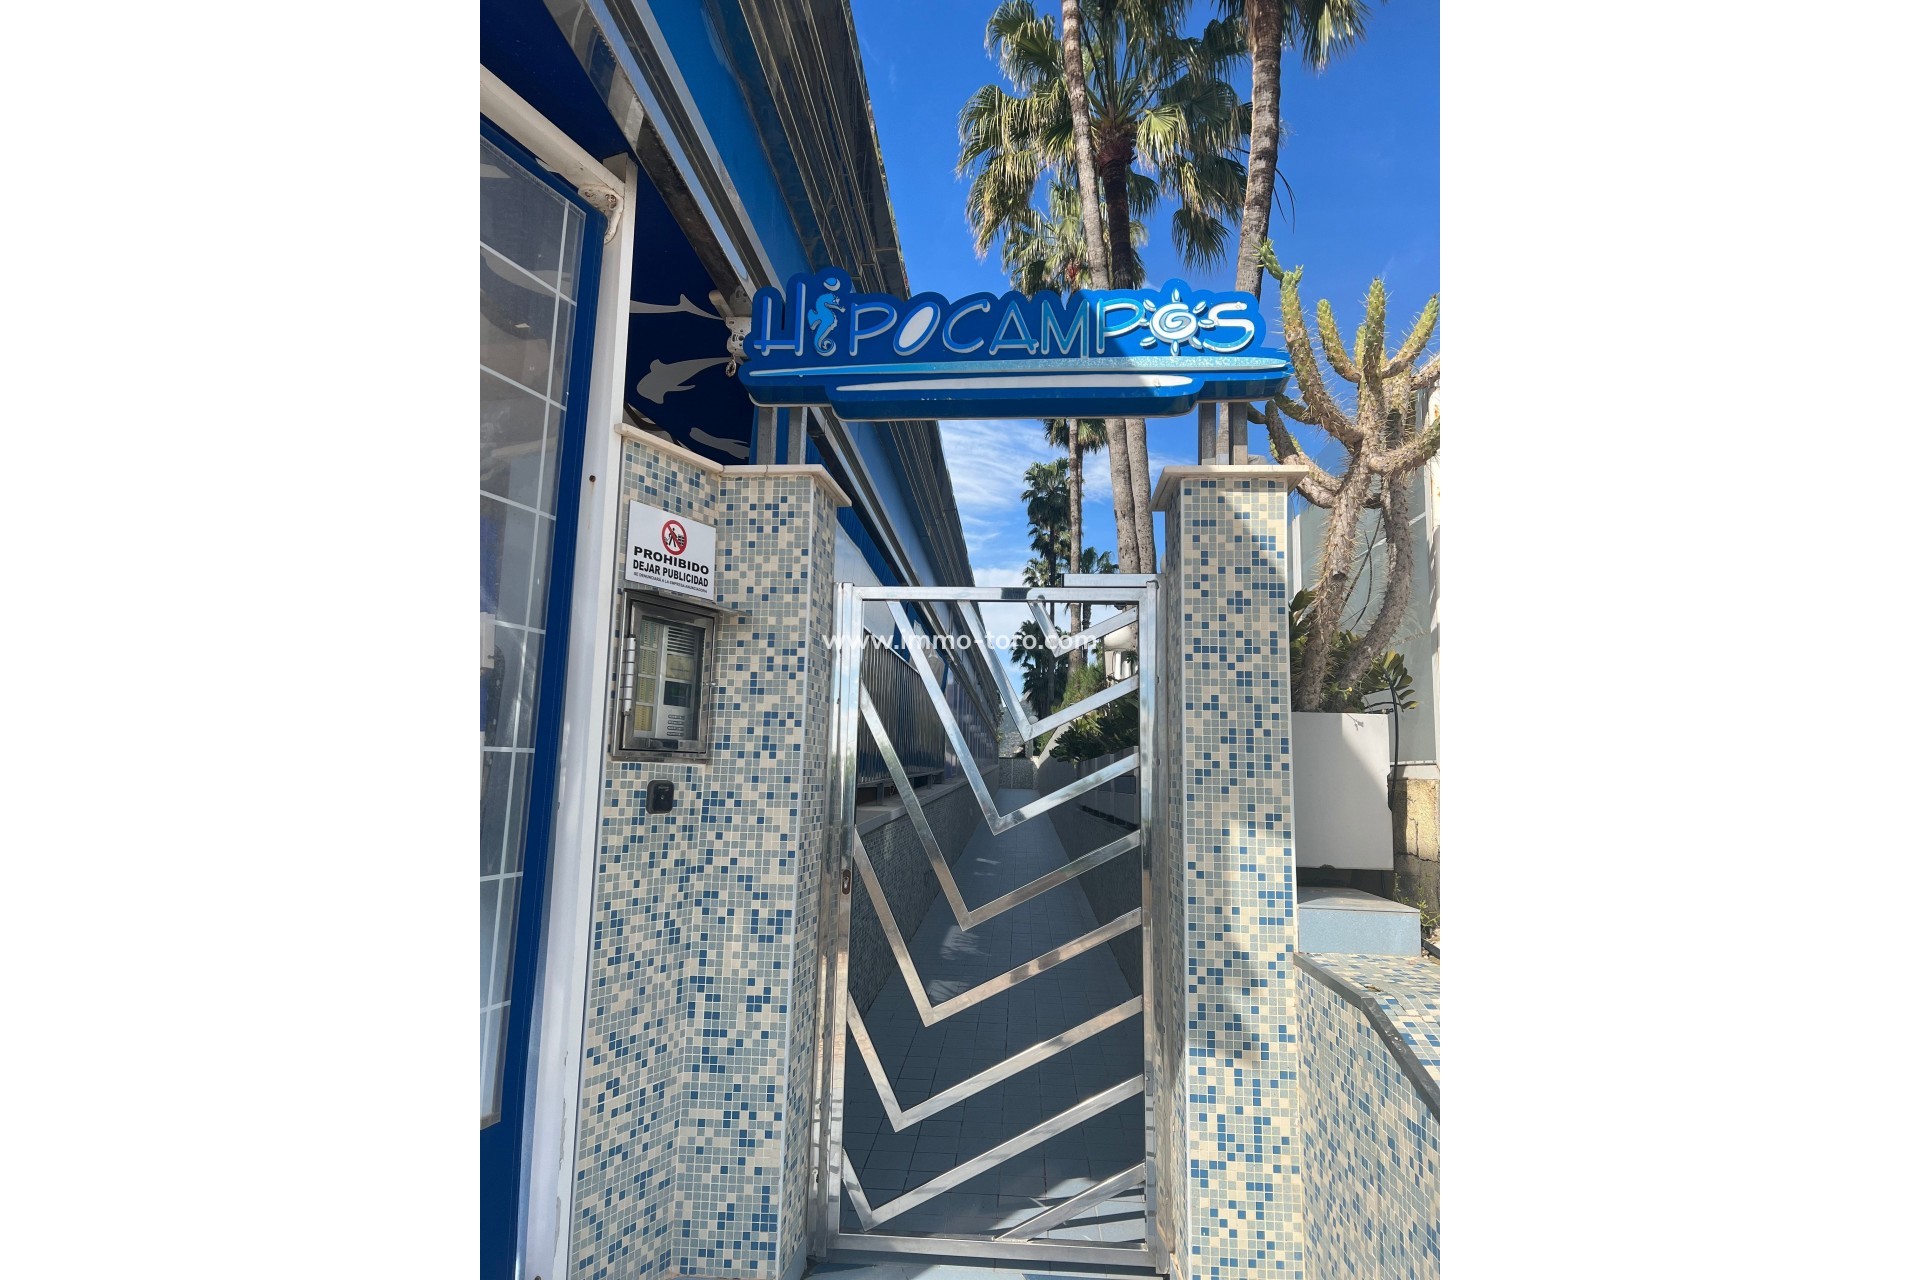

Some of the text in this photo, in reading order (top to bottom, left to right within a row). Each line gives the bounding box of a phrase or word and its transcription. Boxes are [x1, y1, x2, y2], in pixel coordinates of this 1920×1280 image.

[633, 559, 709, 587] DEJAR PUBLICIDAD
[634, 546, 709, 575] PROHIBIDO
